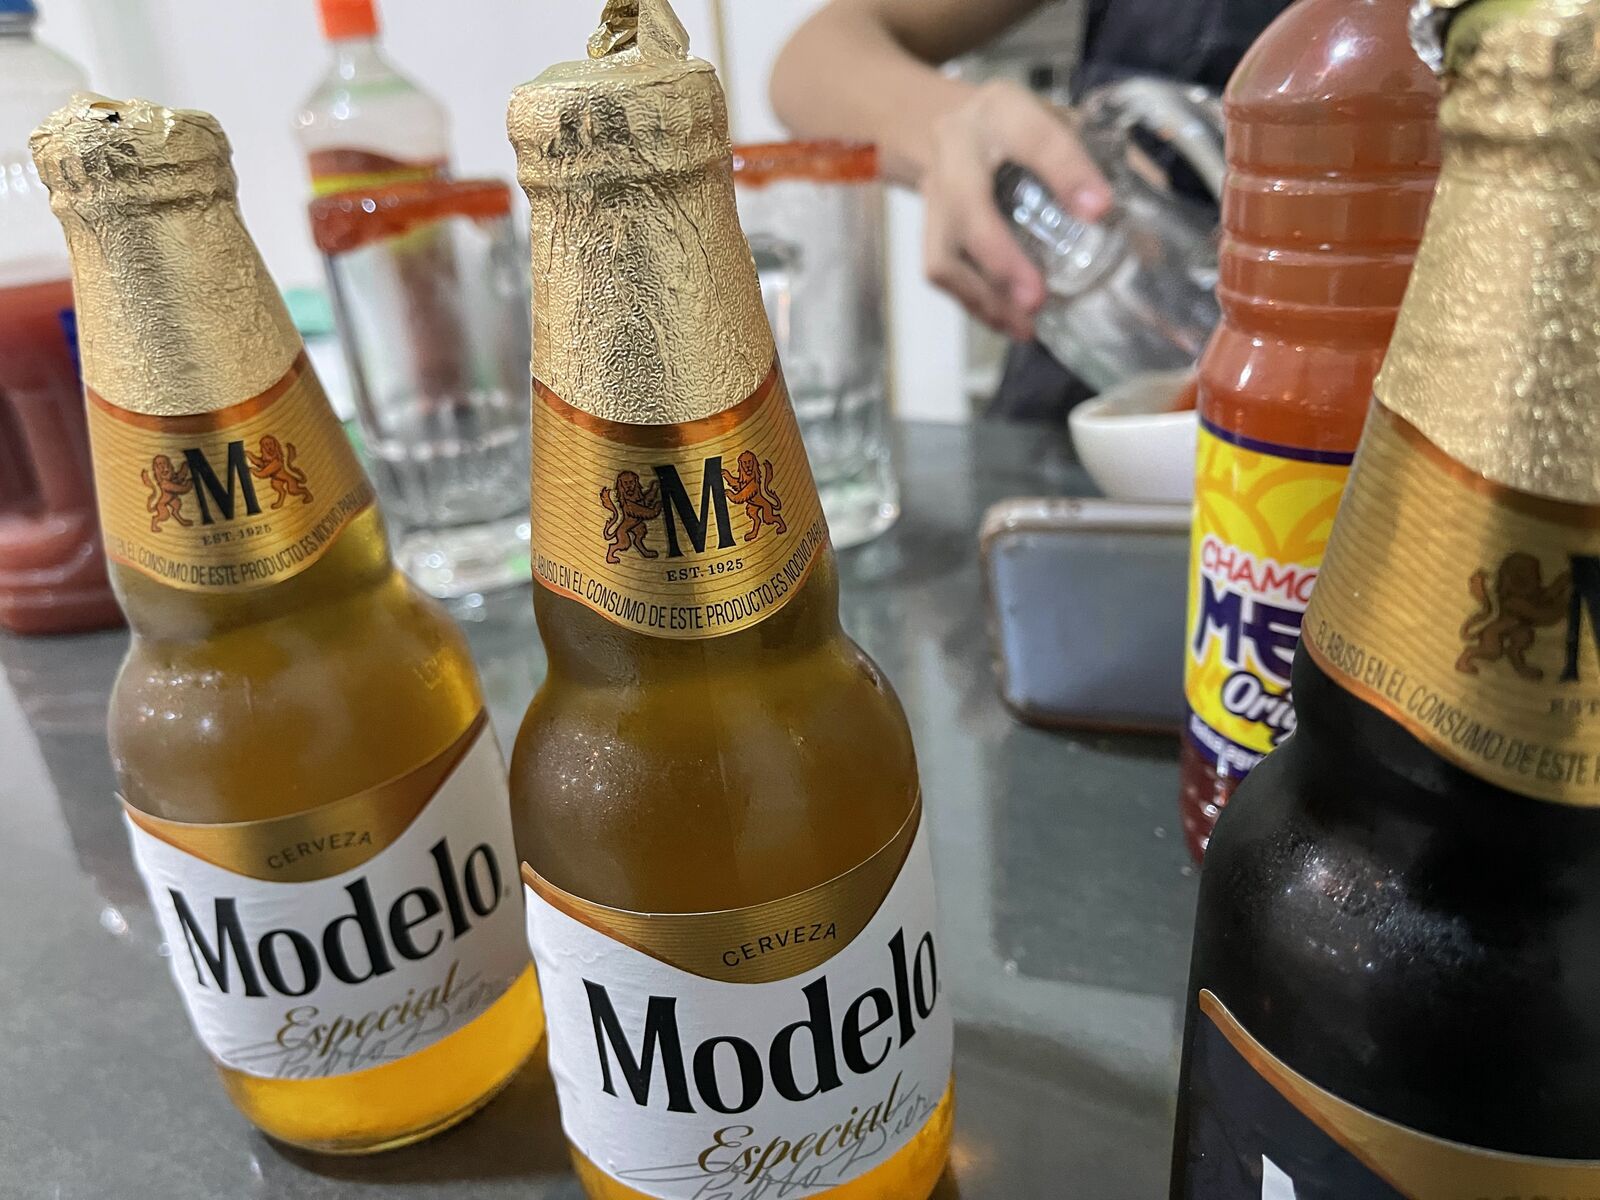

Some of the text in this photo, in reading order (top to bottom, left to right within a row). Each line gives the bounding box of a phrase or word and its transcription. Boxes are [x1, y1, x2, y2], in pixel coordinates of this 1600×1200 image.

[183, 440, 261, 525] M
[654, 456, 736, 557] M
[138, 546, 189, 583] CONSUMO
[191, 565, 207, 585] DE
[208, 565, 240, 586] ESTE
[240, 544, 304, 580] PRODUCTO
[299, 533, 319, 556] ES
[239, 525, 272, 540] 1925
[667, 558, 743, 582] EST. 1925
[559, 565, 571, 589] EN
[573, 570, 583, 595] EL
[587, 579, 646, 624] CONSUMO
[648, 605, 666, 628] DE
[670, 607, 703, 629] ESTE
[706, 584, 774, 627] PRODUCTO
[770, 572, 788, 598] ES
[782, 538, 812, 586] NOCIVO
[1327, 632, 1365, 677] ABUSO
[1363, 656, 1388, 690] EN
[1385, 668, 1406, 703] EL
[1407, 686, 1505, 761] CONSUMO
[1502, 738, 1537, 775] DE
[1535, 748, 1592, 785] ESTE
[267, 829, 374, 870] CERVEZA
[168, 836, 501, 998] Modelo
[722, 921, 838, 968] CERVEZA
[276, 958, 459, 1057] Especial
[581, 926, 938, 1115] Modelo
[698, 1069, 903, 1185] Especial
